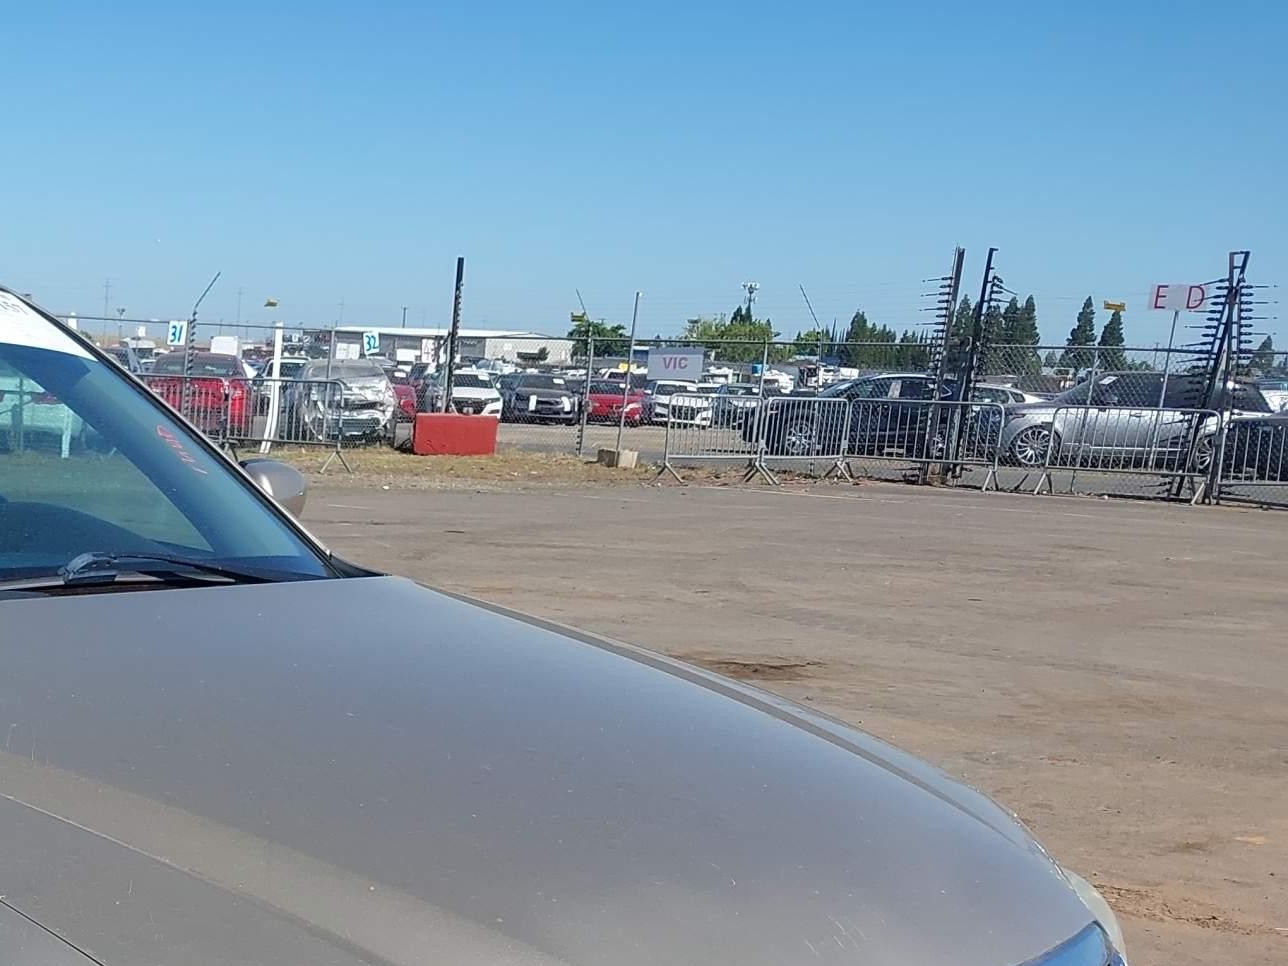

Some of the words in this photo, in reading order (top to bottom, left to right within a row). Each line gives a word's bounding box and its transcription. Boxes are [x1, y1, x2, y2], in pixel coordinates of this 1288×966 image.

[170, 325, 183, 343] 31
[365, 335, 378, 351] 32
[663, 356, 688, 370] VIC
